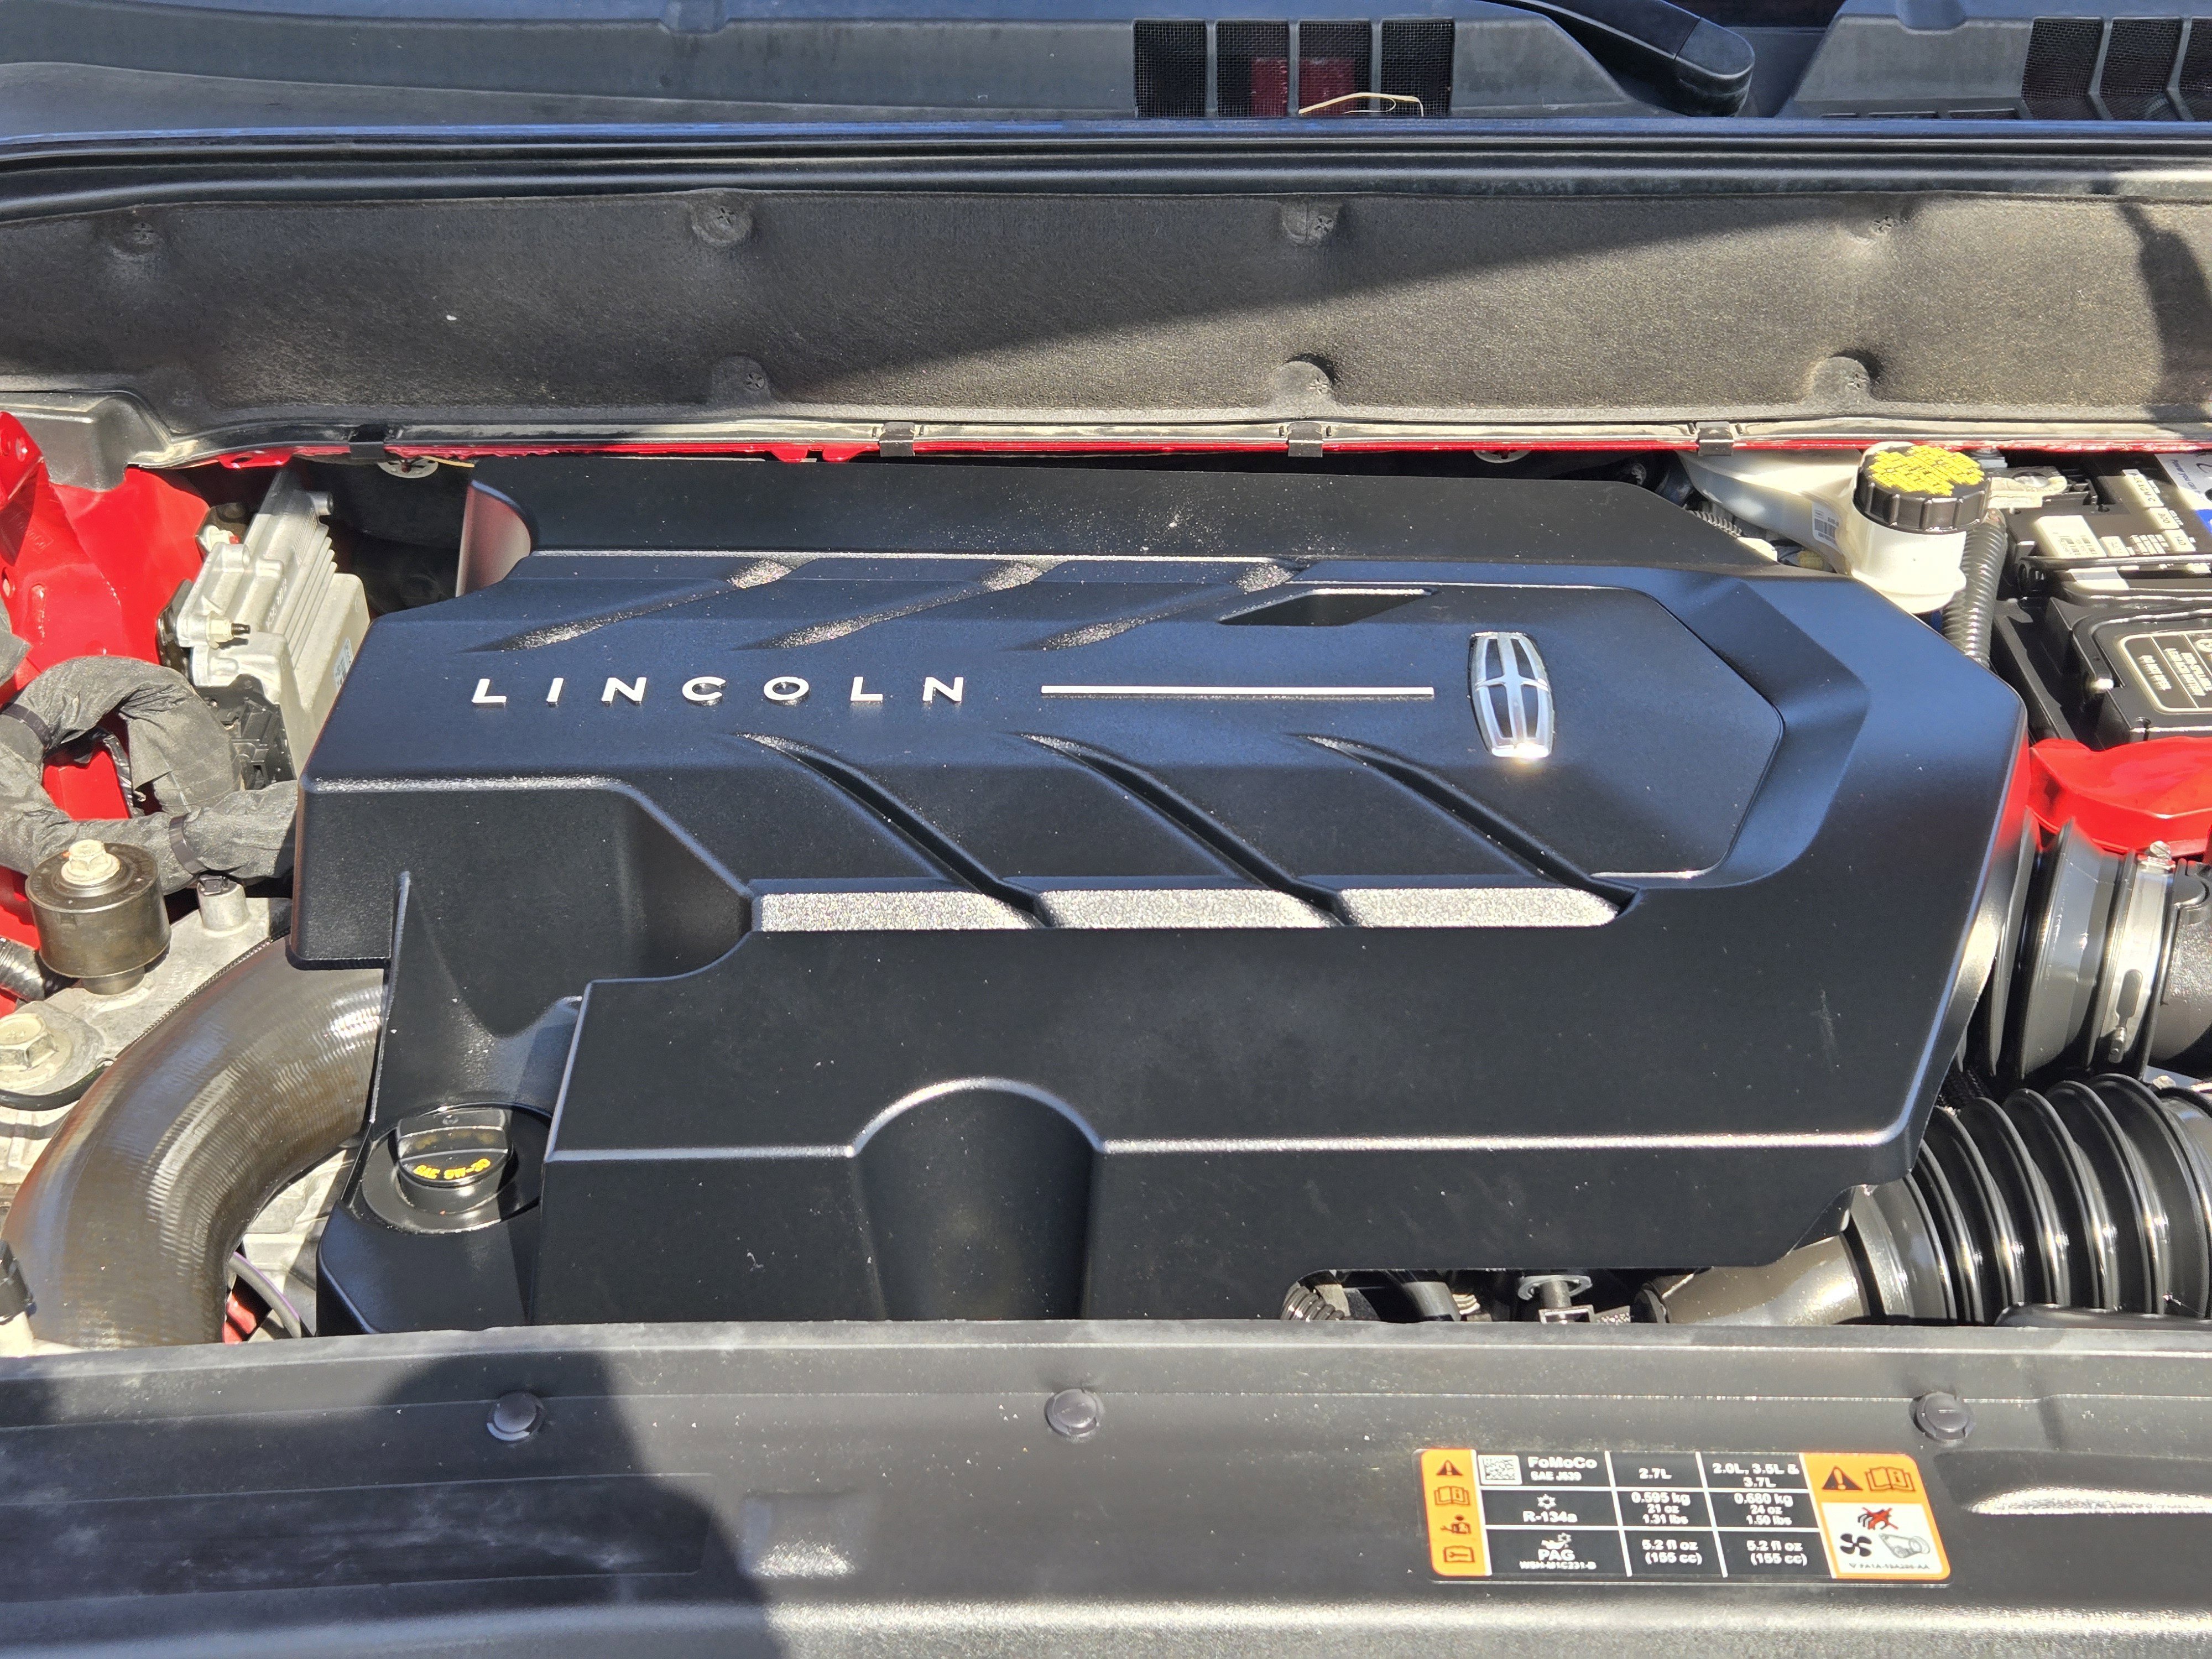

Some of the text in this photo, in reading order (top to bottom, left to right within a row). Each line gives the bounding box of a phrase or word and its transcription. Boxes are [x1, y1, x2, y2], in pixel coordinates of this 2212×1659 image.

[471, 676, 964, 705] LINCOLN
[1528, 1457, 1597, 1469] FoMoCo
[1712, 1463, 1800, 1475] 2.0L, 3.5L &
[1531, 1471, 1554, 1481] SAE
[1639, 1468, 1672, 1479] 2.7L
[1743, 1477, 1776, 1488] 3.7L
[1631, 1491, 1691, 1506] 0.595 kg
[1734, 1493, 1793, 1507] 0.680 kg
[1647, 1504, 1680, 1514] 21 oz
[1750, 1504, 1783, 1515] 24 oz
[1523, 1511, 1578, 1522] R-134a
[1642, 1514, 1689, 1525] 1.31 lbs
[1746, 1515, 1792, 1526] 1.50 lbs
[1641, 1539, 1664, 1551] 5.2
[1679, 1541, 1698, 1551] oz
[1746, 1540, 1769, 1552] 5.2
[1785, 1542, 1803, 1552] oz
[1538, 1549, 1575, 1561] PAG
[1645, 1552, 1703, 1566] (155 cc)
[1750, 1553, 1807, 1566] (155 cc)
